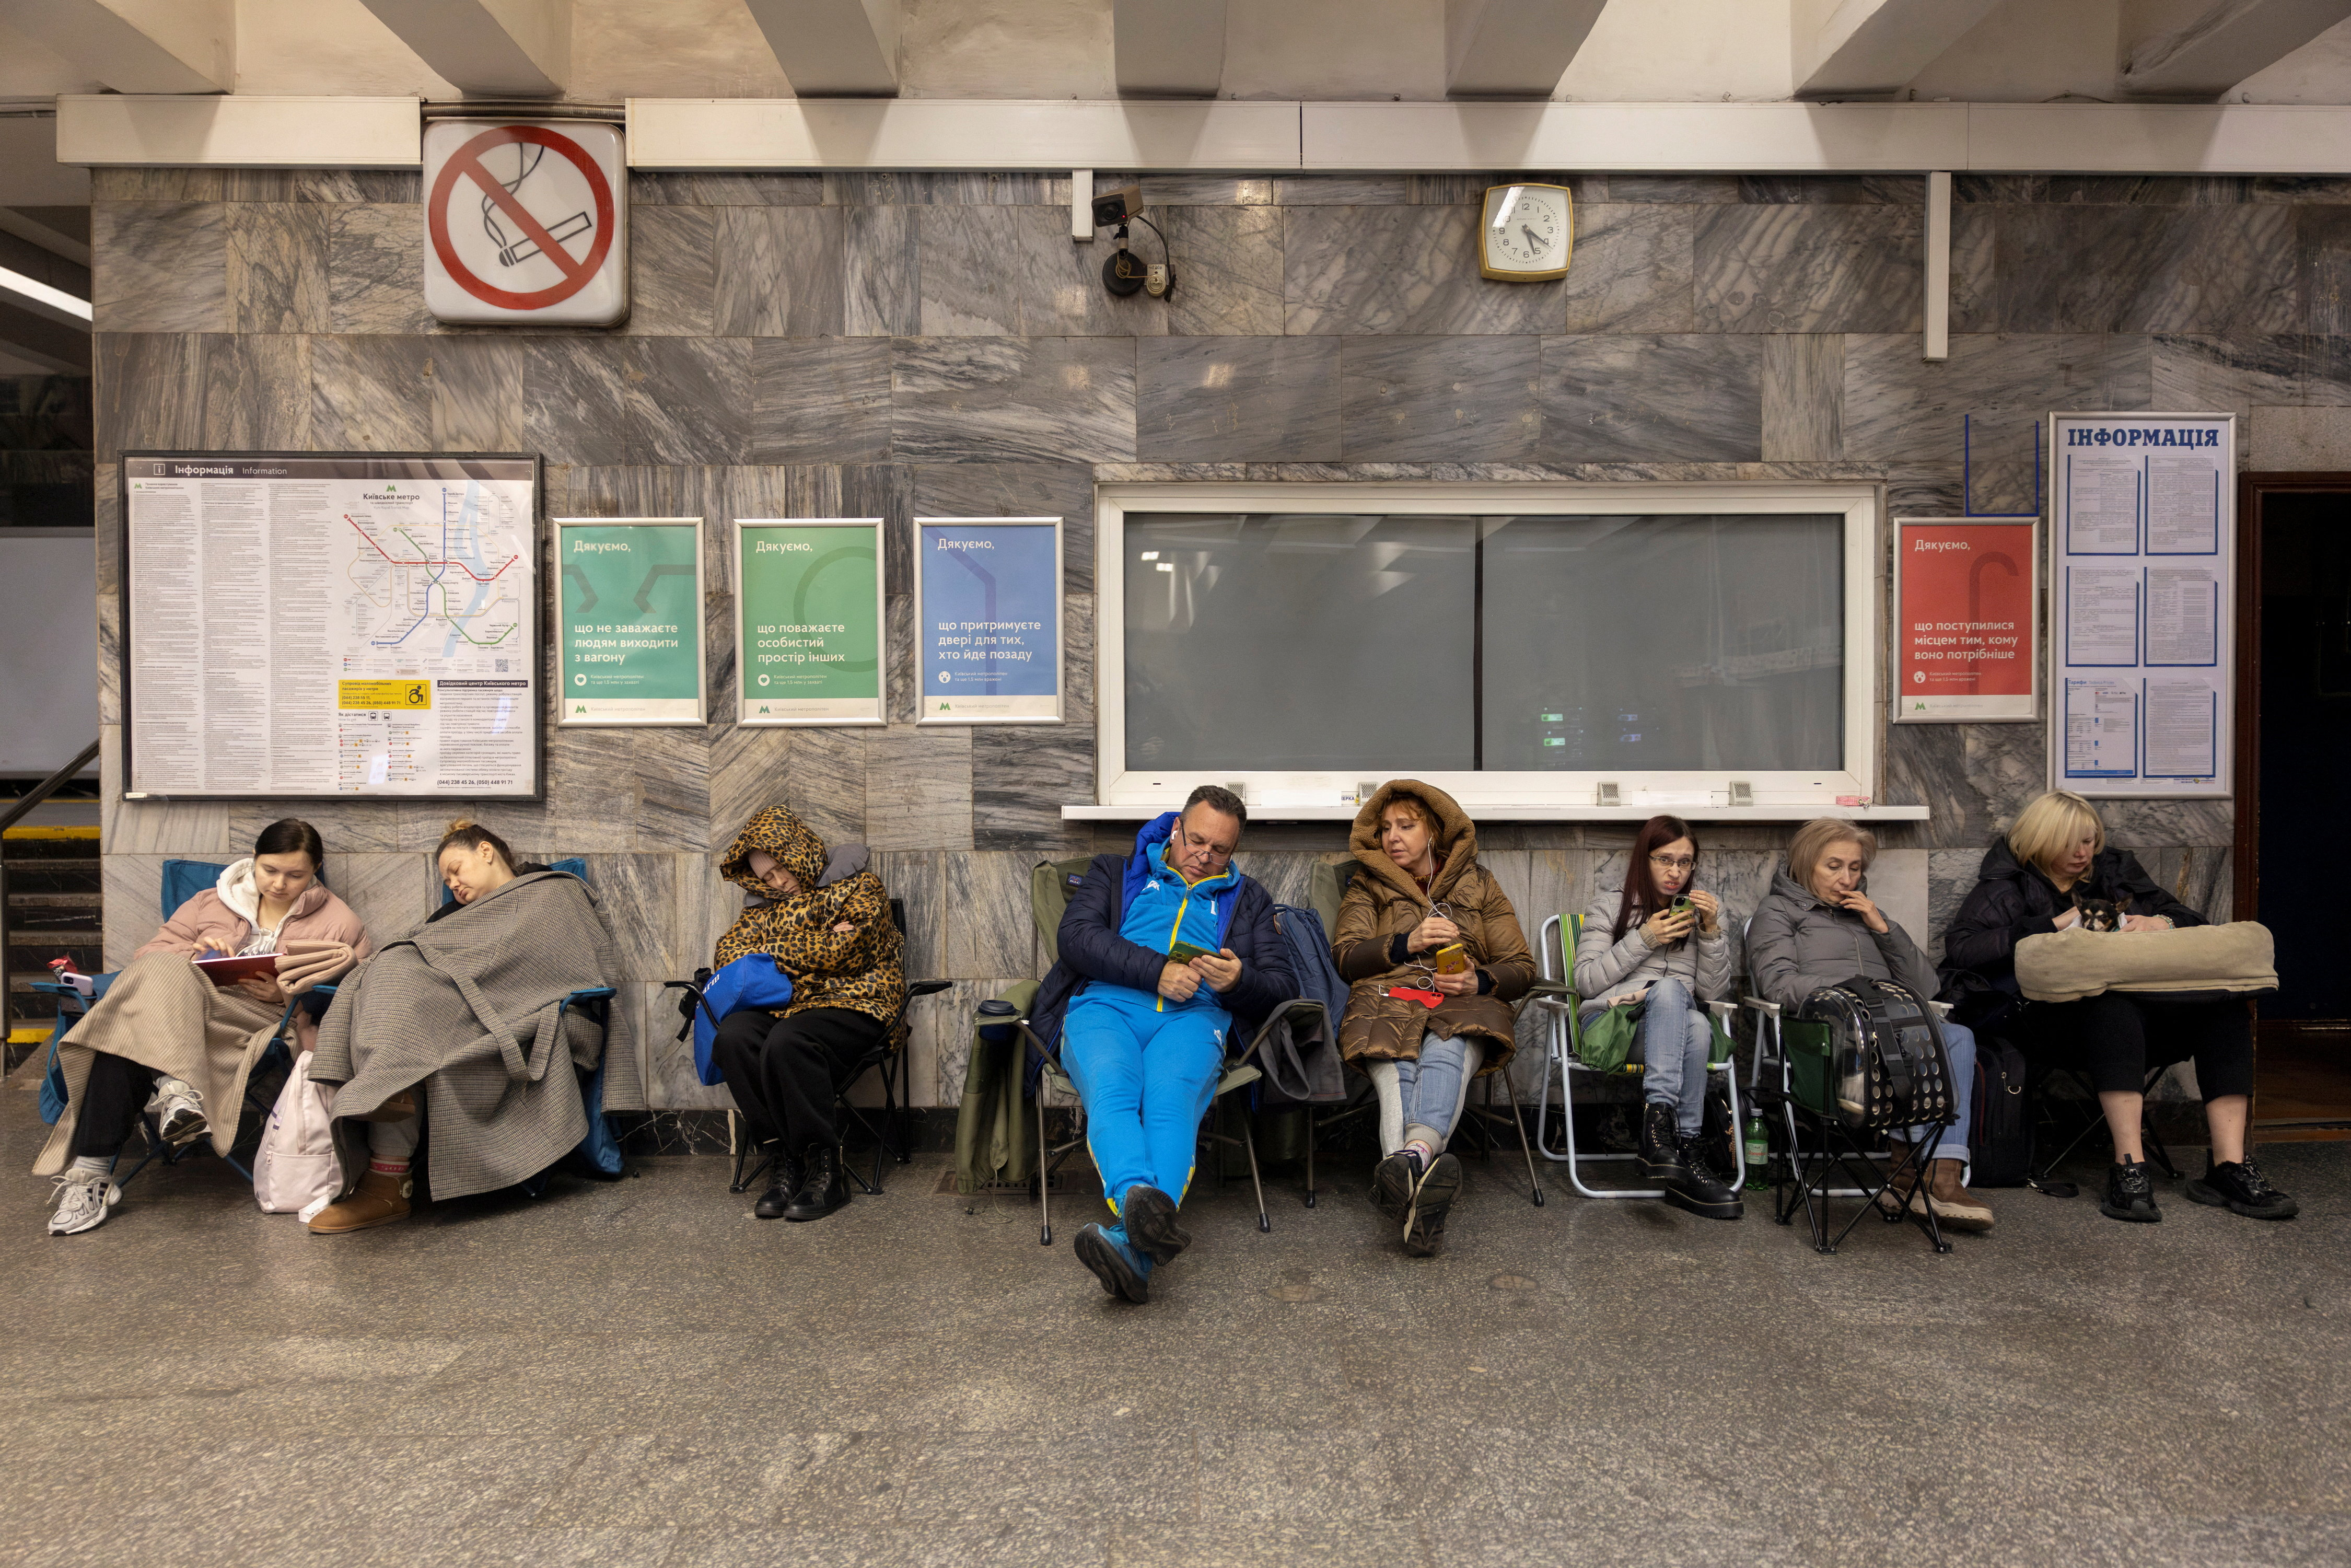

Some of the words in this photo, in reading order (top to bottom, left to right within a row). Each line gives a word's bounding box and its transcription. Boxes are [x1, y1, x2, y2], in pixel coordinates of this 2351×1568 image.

[2068, 428, 2219, 450] ІНФОРМАЦІЯ
[176, 465, 233, 476] Інформація
[242, 467, 287, 475] Information
[574, 540, 631, 554] Дякуємо,
[756, 541, 812, 554] Дякуємо,
[938, 539, 994, 552] Дякуємо,
[1915, 540, 1970, 552] Дякуємо,
[575, 625, 593, 634] що
[758, 625, 775, 634] що
[779, 624, 845, 633] поважаєте
[939, 623, 957, 631] що
[961, 622, 1041, 633] притримуєте
[1915, 623, 1933, 632] що
[1937, 623, 2014, 633] поступилися
[575, 640, 616, 649] людям
[621, 640, 678, 648] виходити
[758, 637, 823, 647] особистий
[938, 634, 971, 647] двері
[975, 637, 996, 646] для
[1000, 637, 1024, 645] тих,
[1915, 635, 1956, 646] місцем
[1989, 637, 2018, 647] кому
[585, 654, 625, 665] вагону
[759, 652, 805, 665] простір
[809, 652, 845, 661] інших
[964, 649, 986, 660] йде
[991, 652, 1032, 661] позаду
[1914, 652, 1944, 660] воно
[1948, 648, 2015, 661] потрібніше
